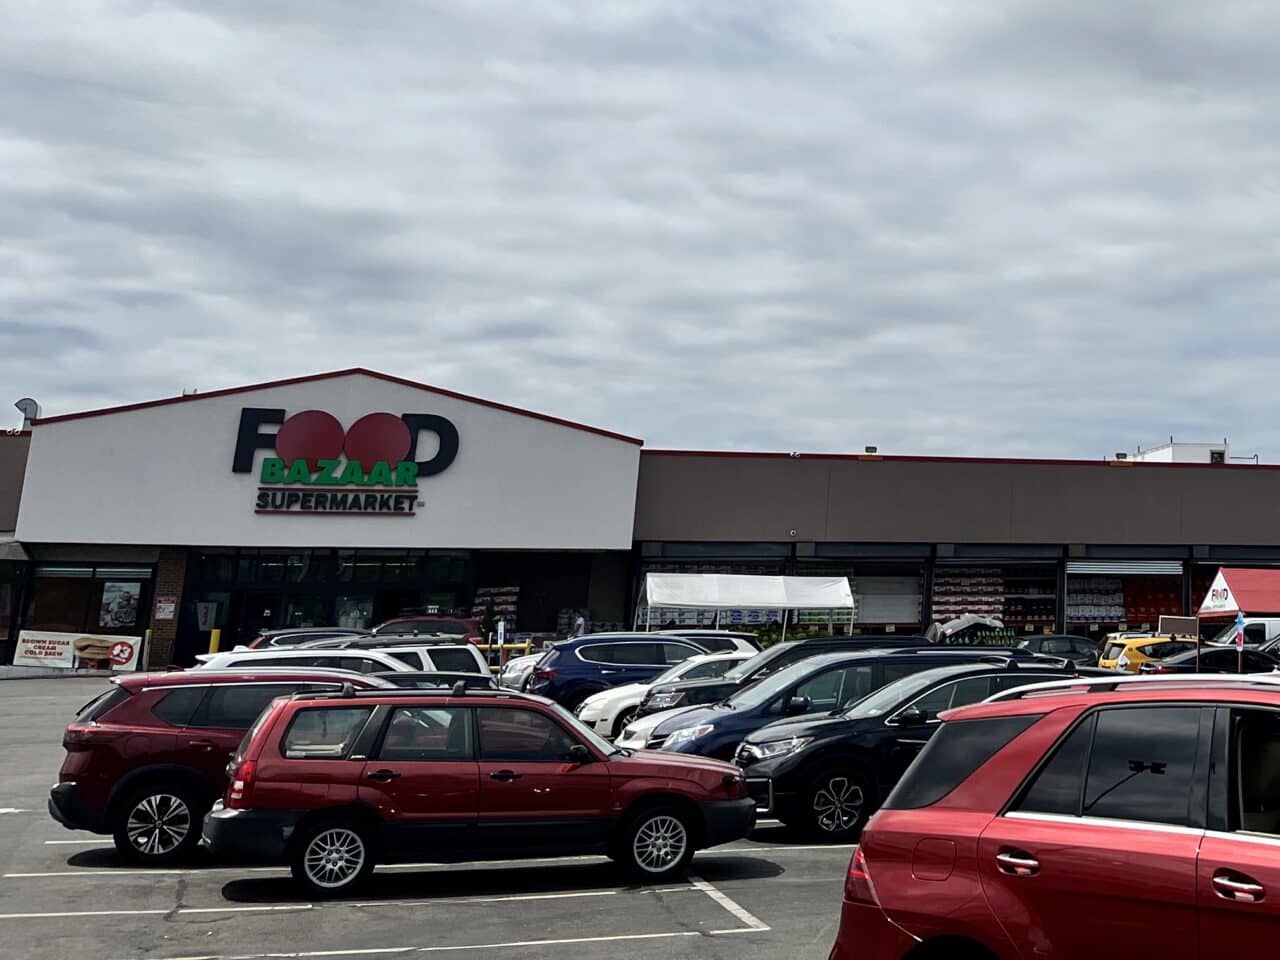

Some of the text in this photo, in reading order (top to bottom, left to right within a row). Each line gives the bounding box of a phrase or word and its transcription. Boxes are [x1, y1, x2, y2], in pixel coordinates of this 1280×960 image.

[232, 407, 459, 478] FOOD
[260, 457, 418, 487] BAZAAR
[256, 491, 418, 512] SUPERMARKET
